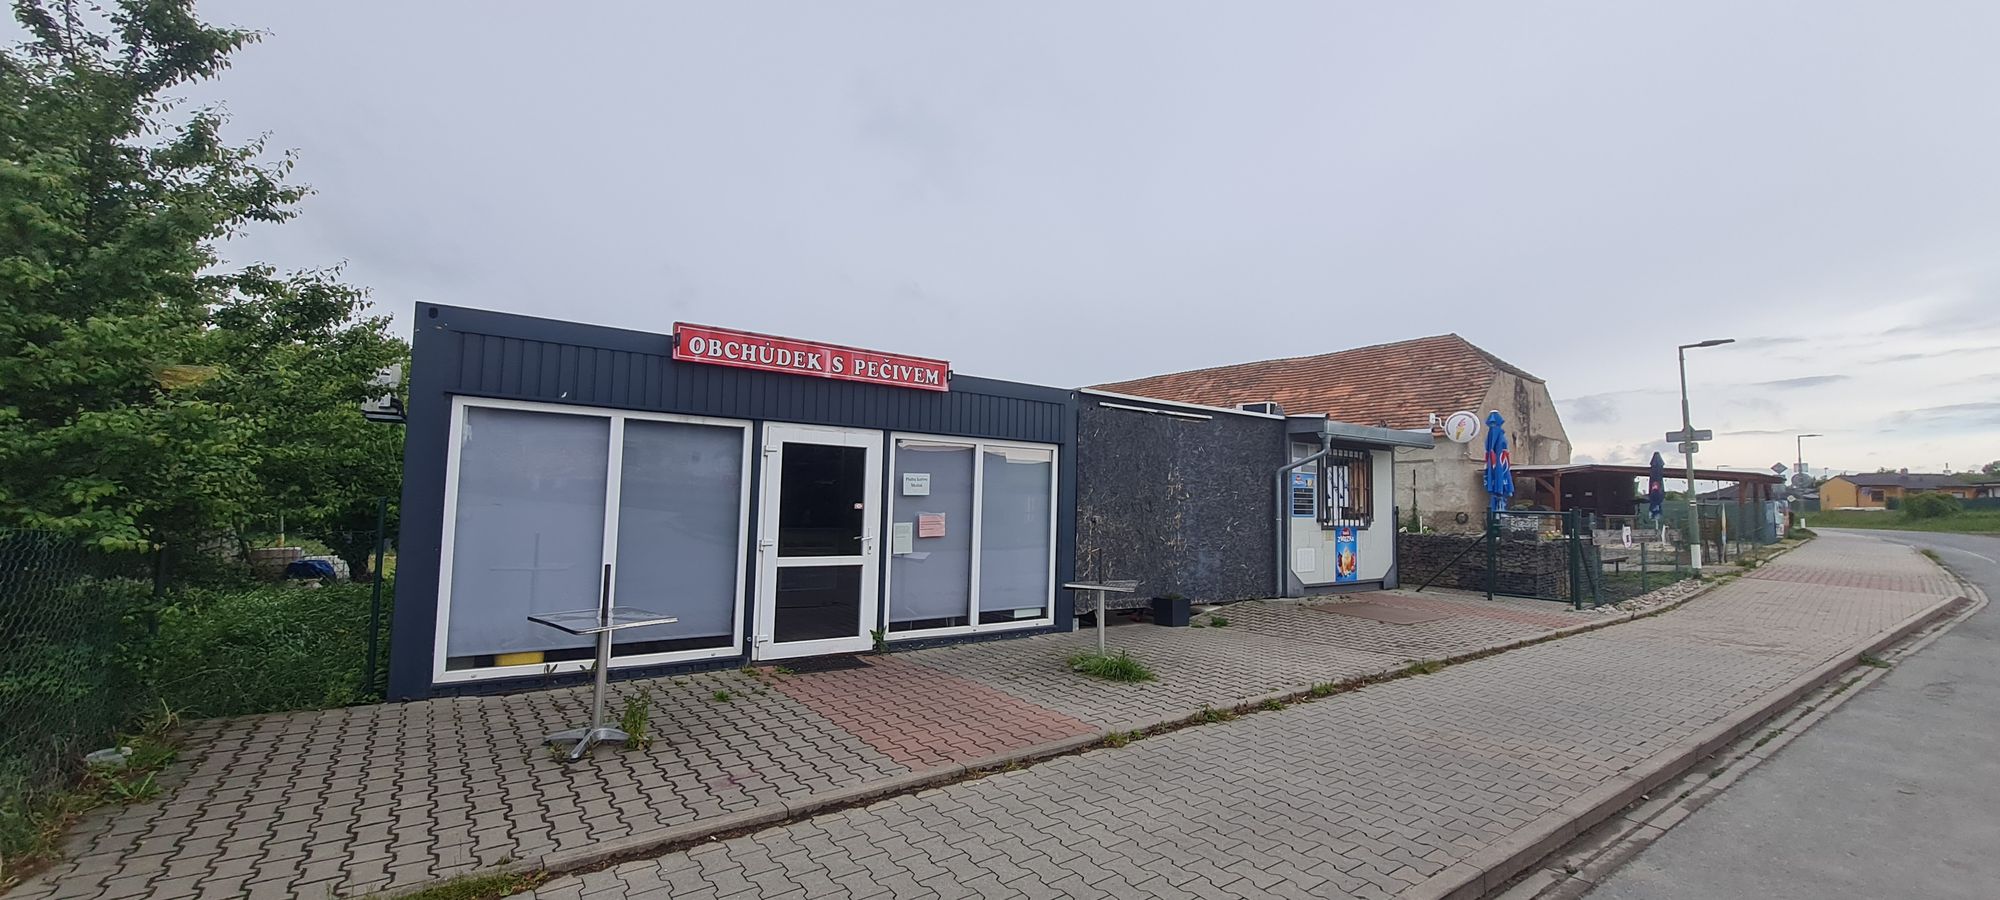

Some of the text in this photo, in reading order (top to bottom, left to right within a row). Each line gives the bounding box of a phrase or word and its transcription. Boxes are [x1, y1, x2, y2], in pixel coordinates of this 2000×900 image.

[689, 336, 939, 385] OBCHŮDEK S PEČIVEM
